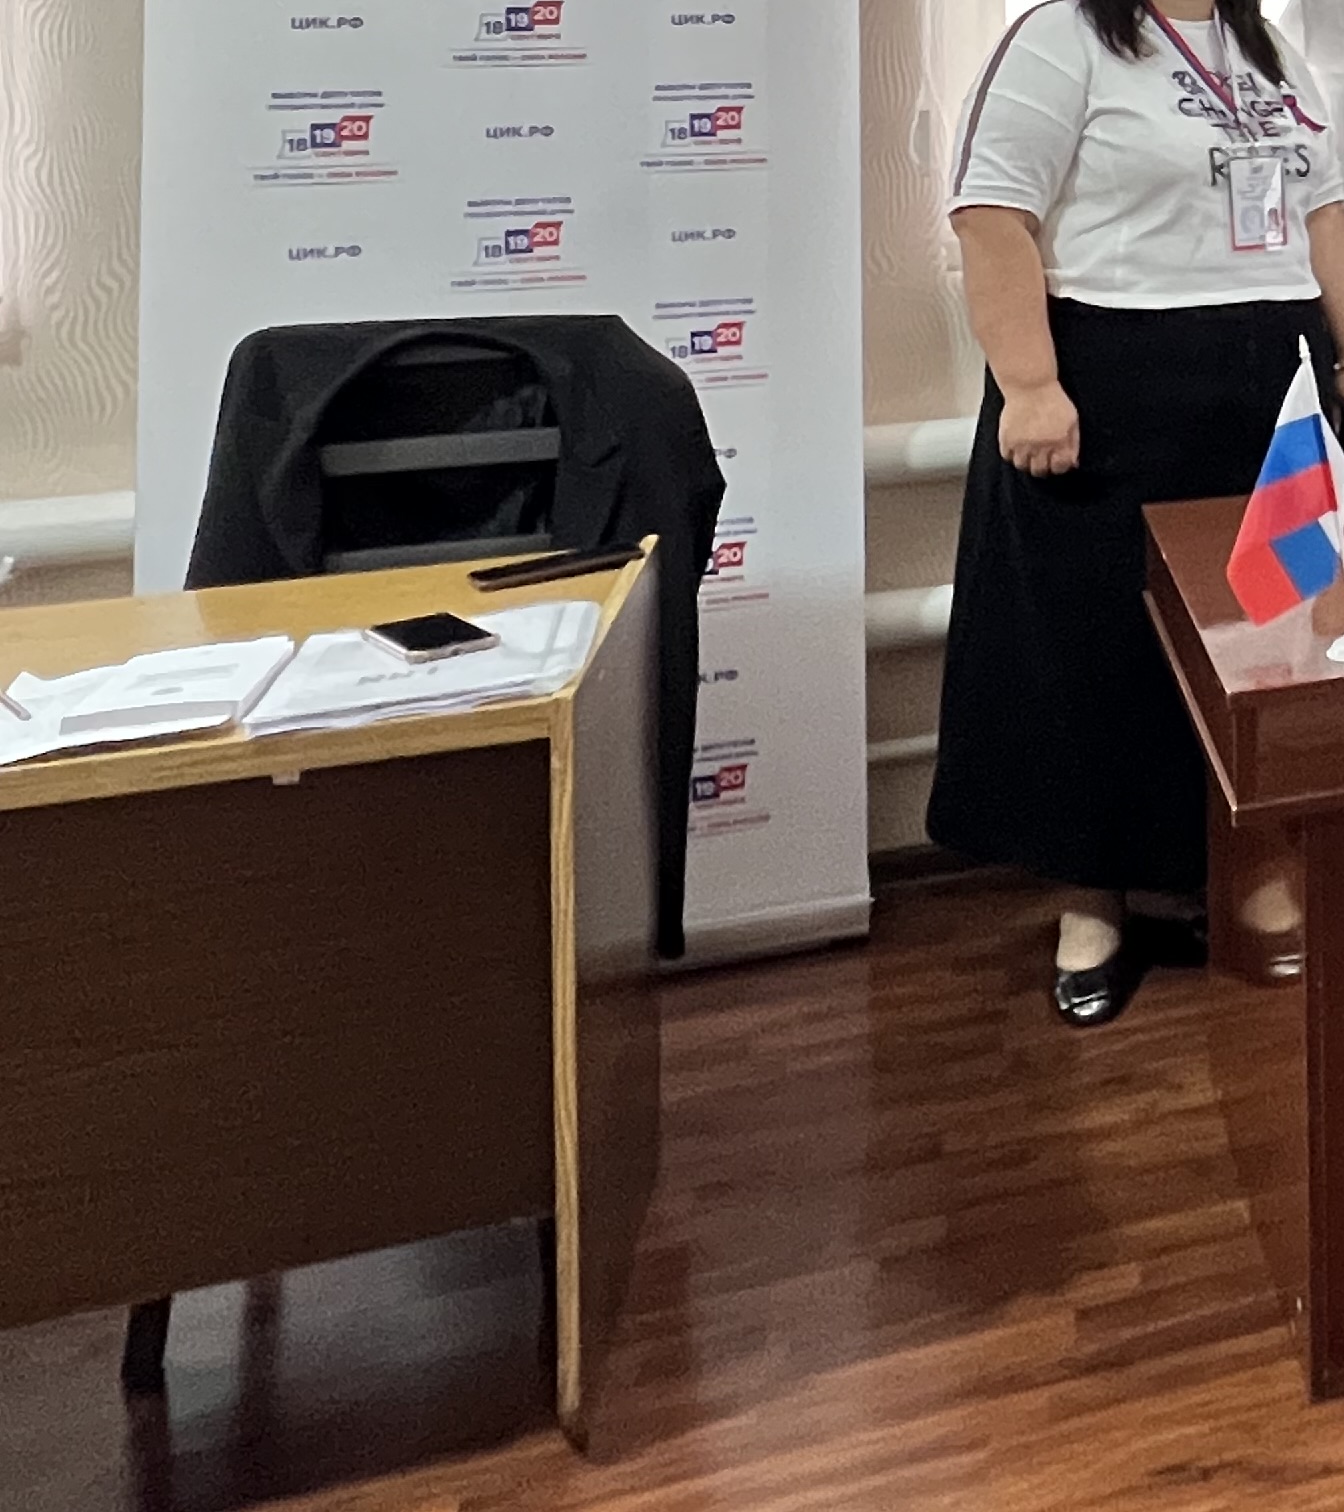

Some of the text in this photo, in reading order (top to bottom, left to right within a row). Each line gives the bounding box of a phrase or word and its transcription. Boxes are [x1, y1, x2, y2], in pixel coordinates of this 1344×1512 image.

[533, 5, 558, 21] 20
[291, 16, 364, 30] ЦИК.РФ
[716, 110, 740, 126] 20
[340, 120, 367, 136] 20
[485, 125, 555, 139] ЦИК.РФ
[532, 225, 558, 242] 20
[716, 327, 741, 343] 20
[717, 546, 742, 564] 20
[719, 770, 742, 788] 20
